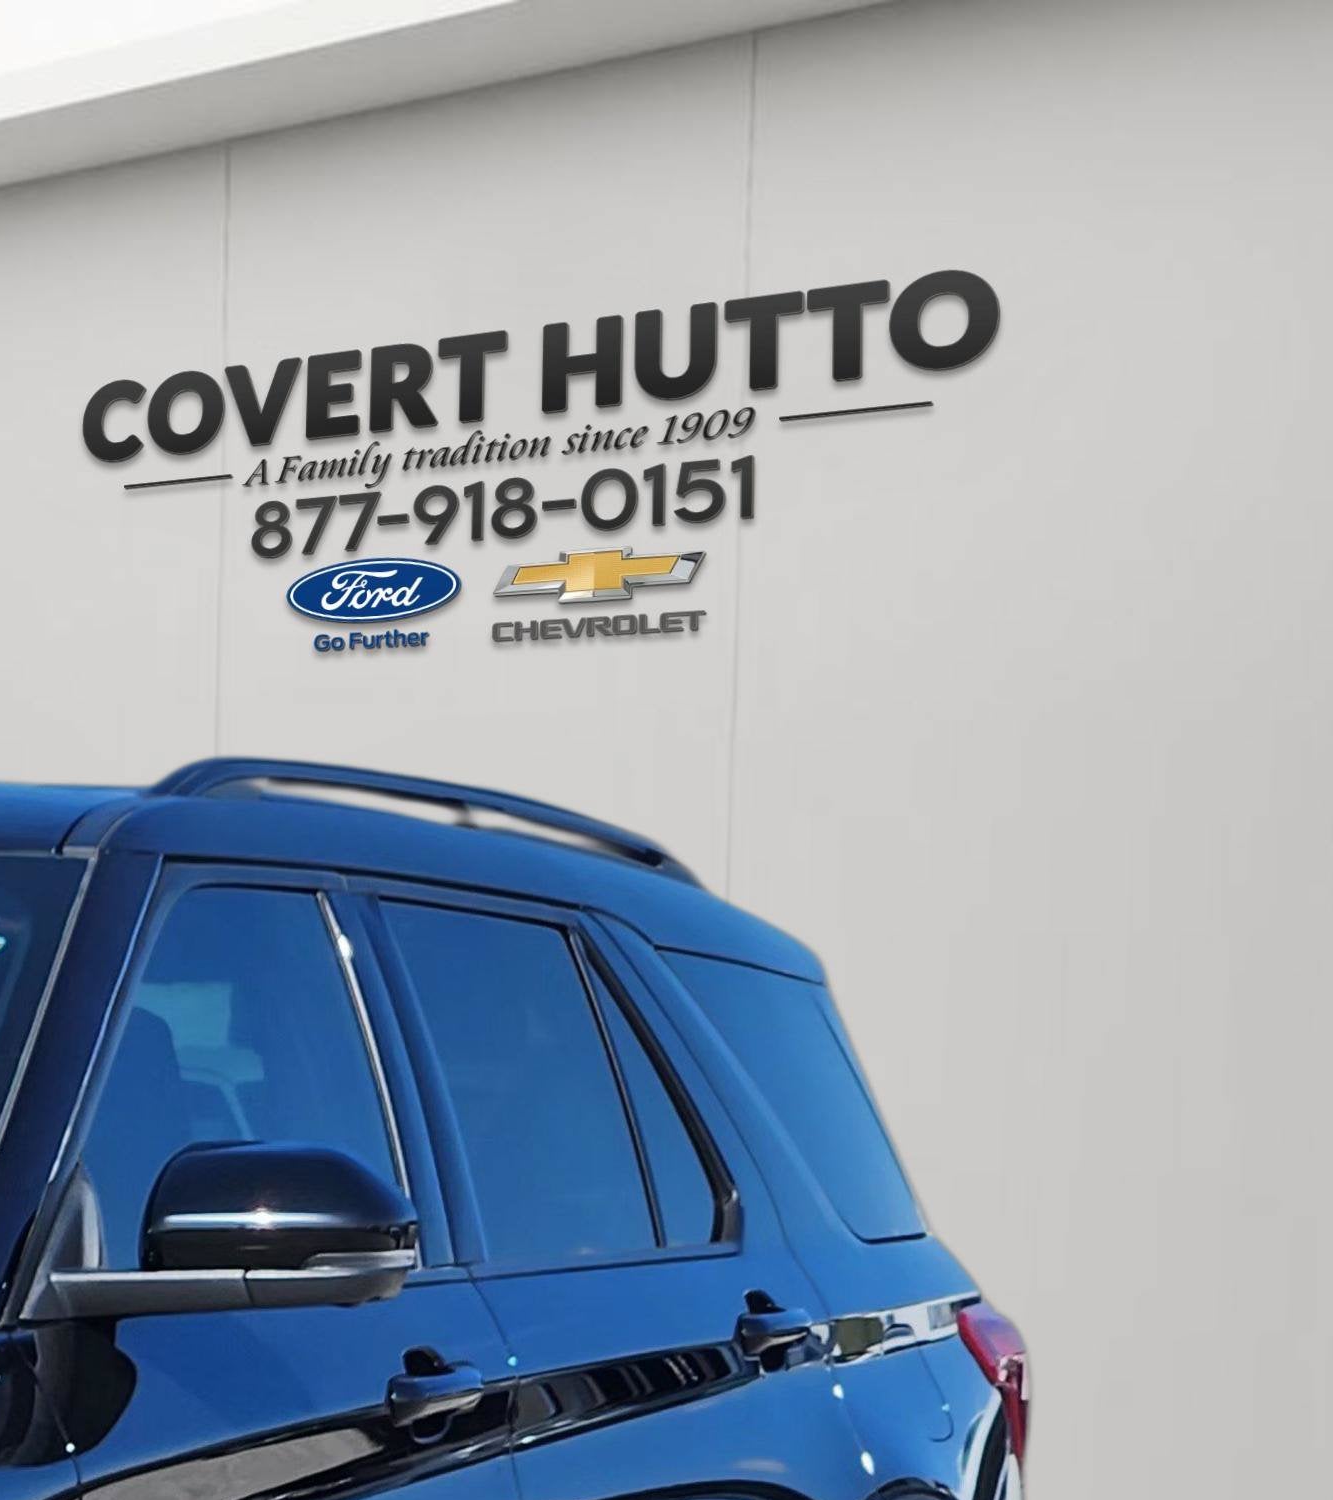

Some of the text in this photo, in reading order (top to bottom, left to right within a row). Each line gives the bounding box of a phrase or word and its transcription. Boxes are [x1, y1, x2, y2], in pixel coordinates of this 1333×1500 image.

[82, 270, 1000, 463] COVERT HUTTO
[243, 406, 755, 488] A Family tradition since 1909
[250, 455, 755, 558] 877-918-0151
[321, 568, 423, 610] Ford
[313, 629, 430, 652] Go Further
[491, 610, 706, 643] CHEVROLET
